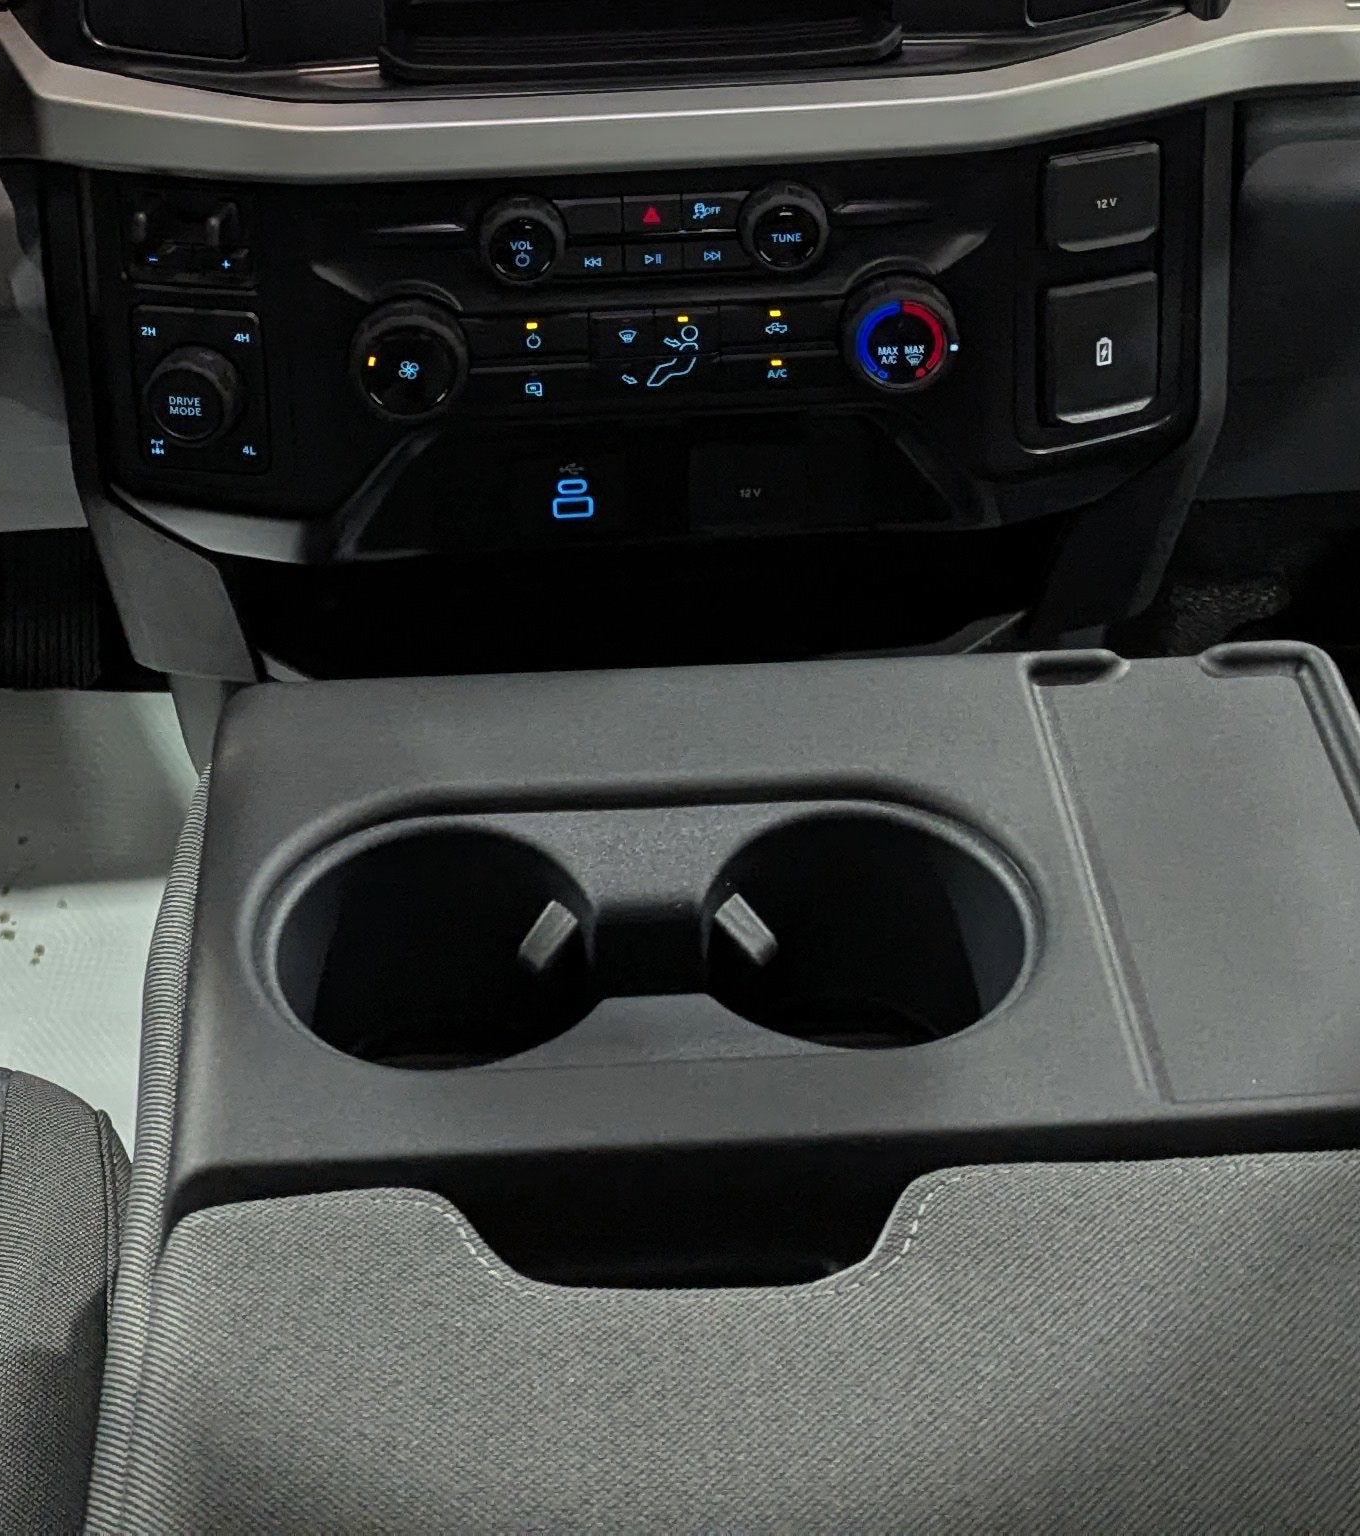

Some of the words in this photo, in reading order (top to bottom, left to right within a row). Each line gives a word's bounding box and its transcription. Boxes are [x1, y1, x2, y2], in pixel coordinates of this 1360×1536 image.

[1096, 198, 1108, 210] 12
[704, 205, 721, 216] OFF
[771, 232, 802, 243] TUNE
[509, 240, 533, 251] VOL
[140, 326, 157, 337] 2H
[233, 332, 251, 344] 4H
[877, 345, 899, 356] MAX
[904, 344, 925, 355] MAX
[880, 355, 898, 365] A/C
[767, 368, 788, 379] A/C
[168, 395, 201, 407] DRIVE
[168, 405, 202, 417] MODE
[242, 444, 257, 457] 4L
